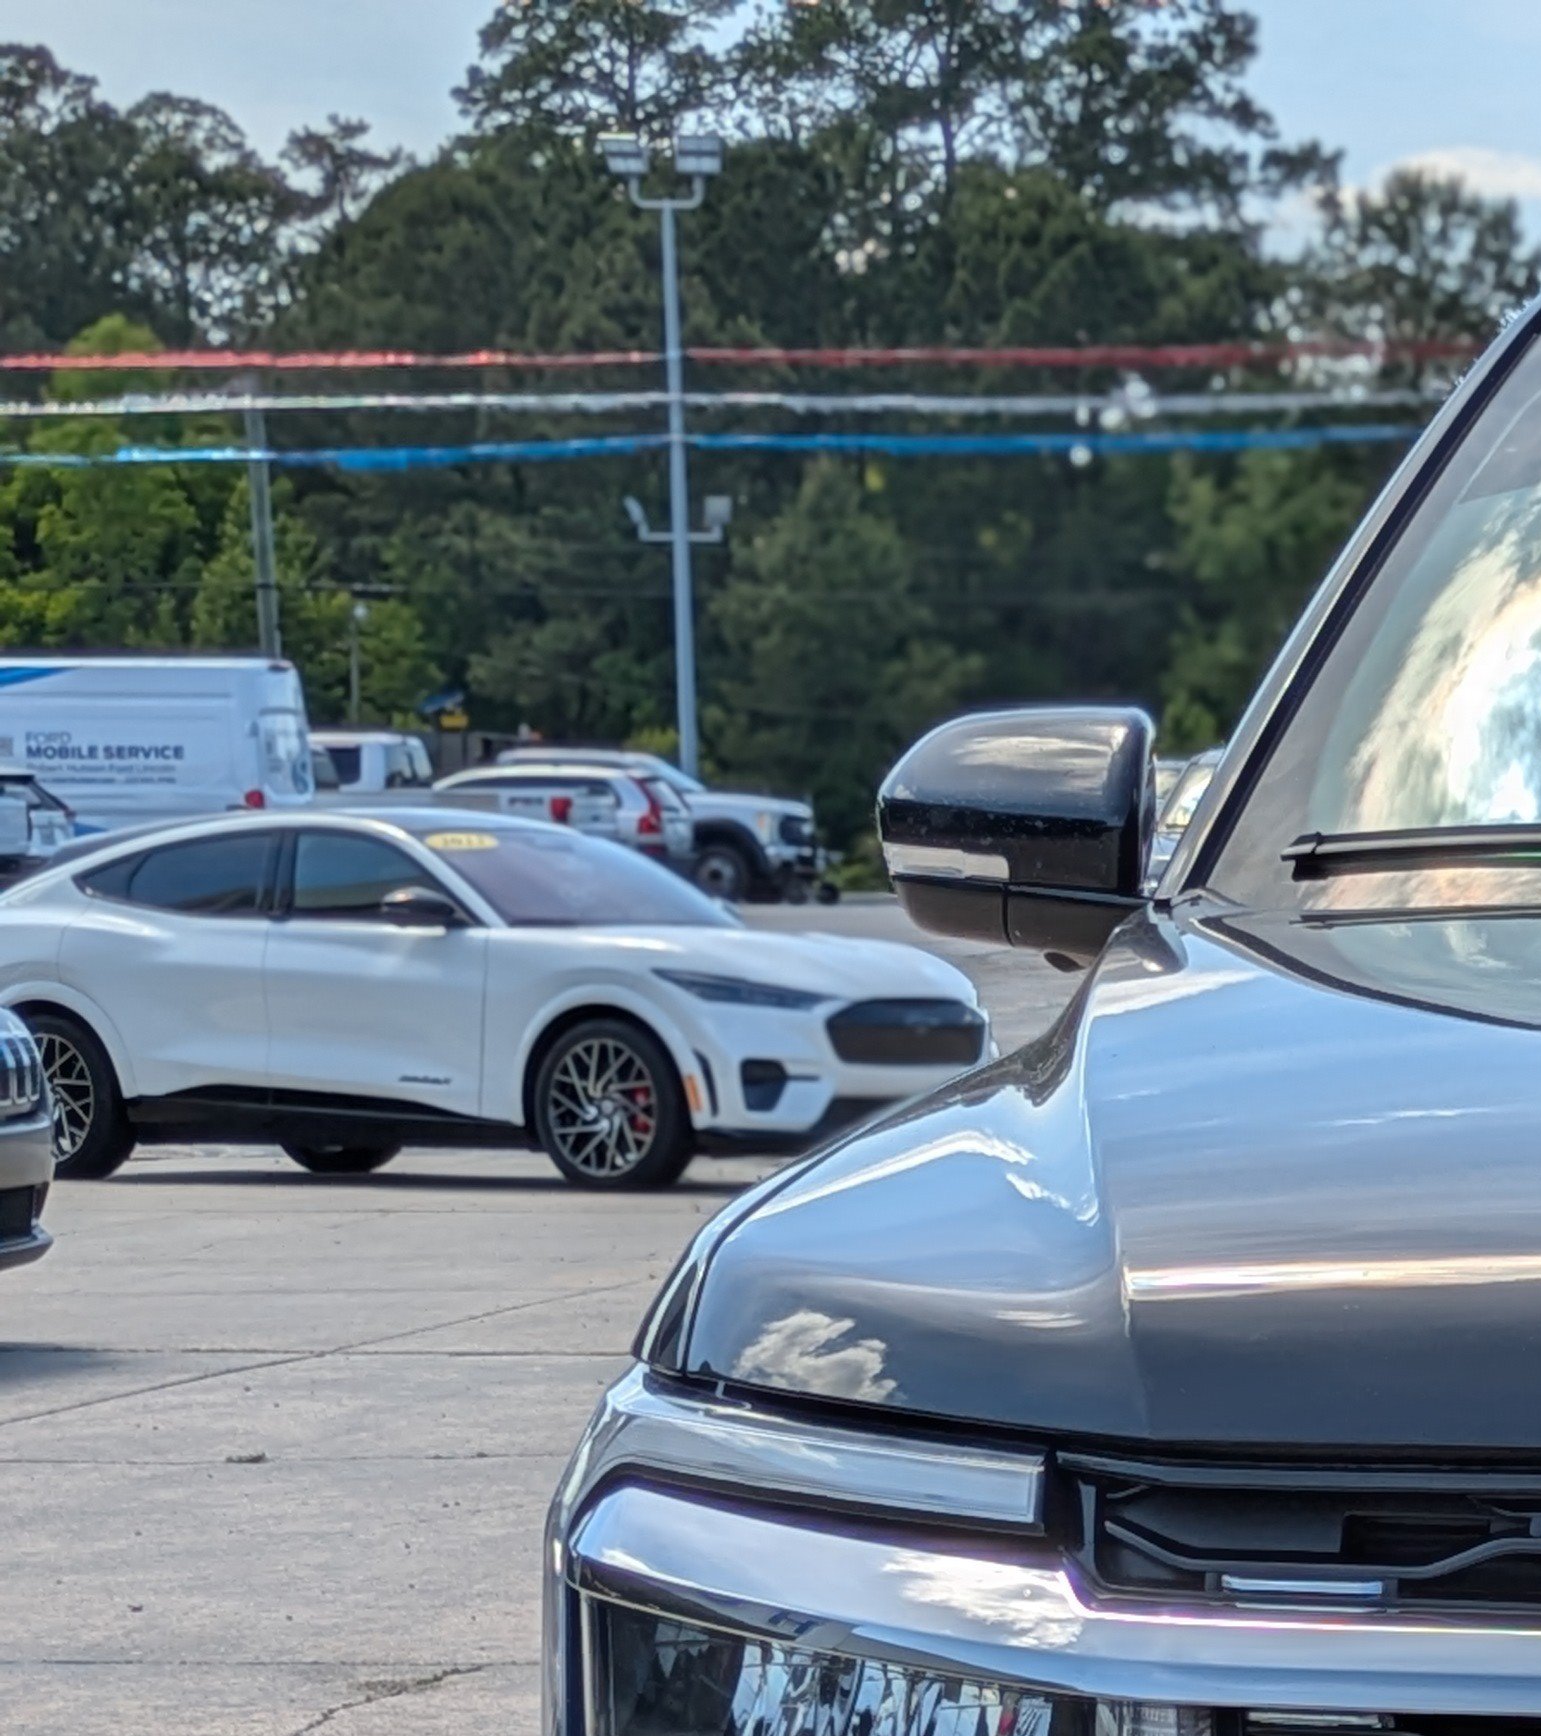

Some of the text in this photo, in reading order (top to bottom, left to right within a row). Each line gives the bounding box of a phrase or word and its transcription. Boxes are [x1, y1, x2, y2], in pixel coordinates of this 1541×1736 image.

[25, 731, 72, 744] FORD
[25, 745, 184, 760] MOBILE SERVICE
